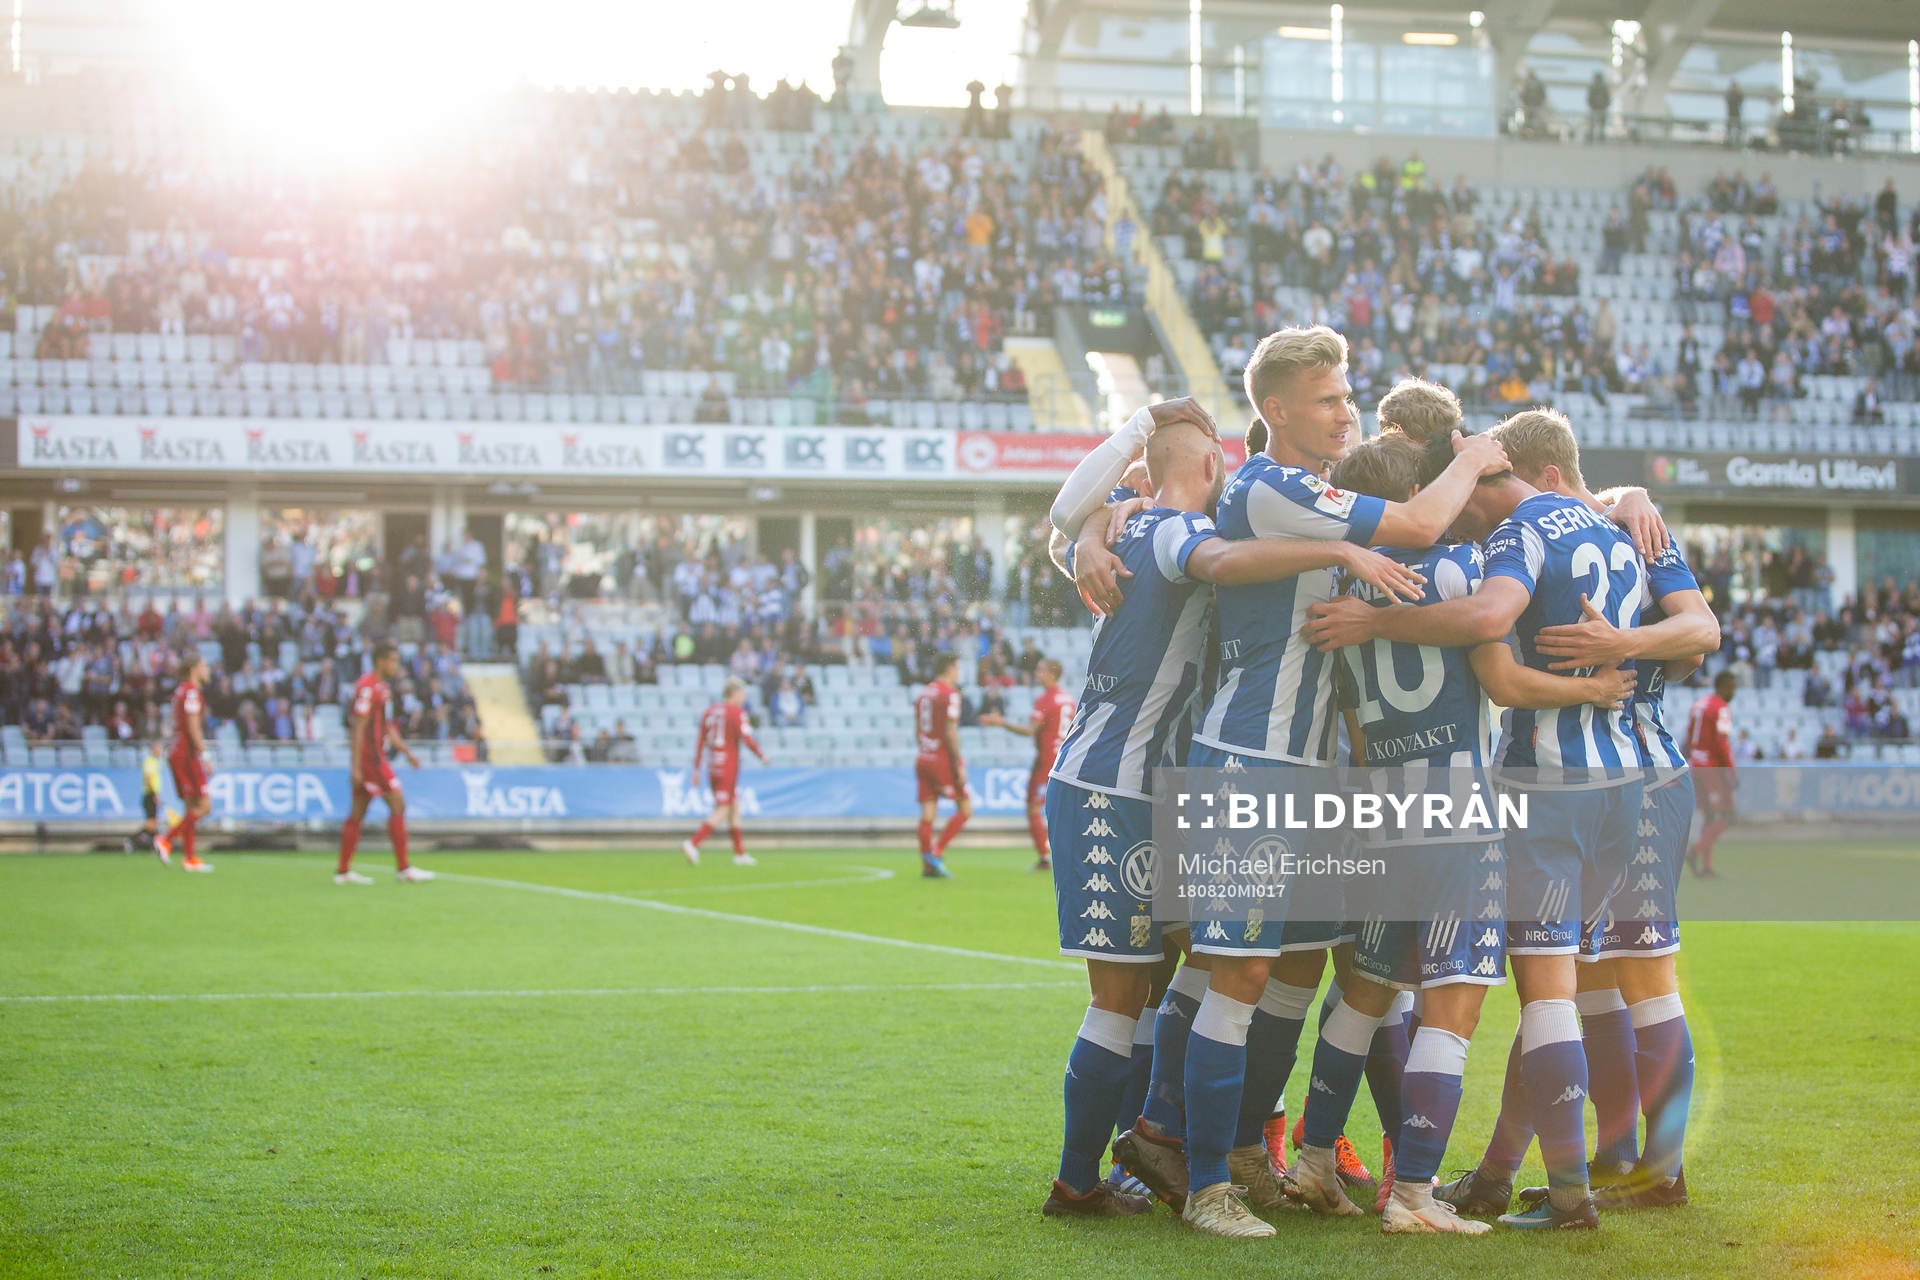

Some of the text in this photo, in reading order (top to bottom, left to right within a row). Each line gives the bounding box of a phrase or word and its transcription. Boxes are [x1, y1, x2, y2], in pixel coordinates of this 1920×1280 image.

[32, 435, 118, 460] RASTA
[140, 436, 225, 462] RASTA
[247, 438, 331, 464] RASTA
[353, 439, 437, 465] RASTA
[458, 440, 543, 467] RASTA
[562, 441, 645, 468] RASTA
[1726, 456, 1816, 487] Gamla
[1819, 459, 1897, 490] Ullevi
[1537, 504, 1619, 541] SERN
[1571, 541, 1642, 630] 22
[1343, 602, 1445, 728] 10
[466, 782, 567, 816] RASTA
[662, 782, 761, 816] RAA
[1525, 929, 1573, 941] NRC Group
[1440, 960, 1464, 971] Goup
